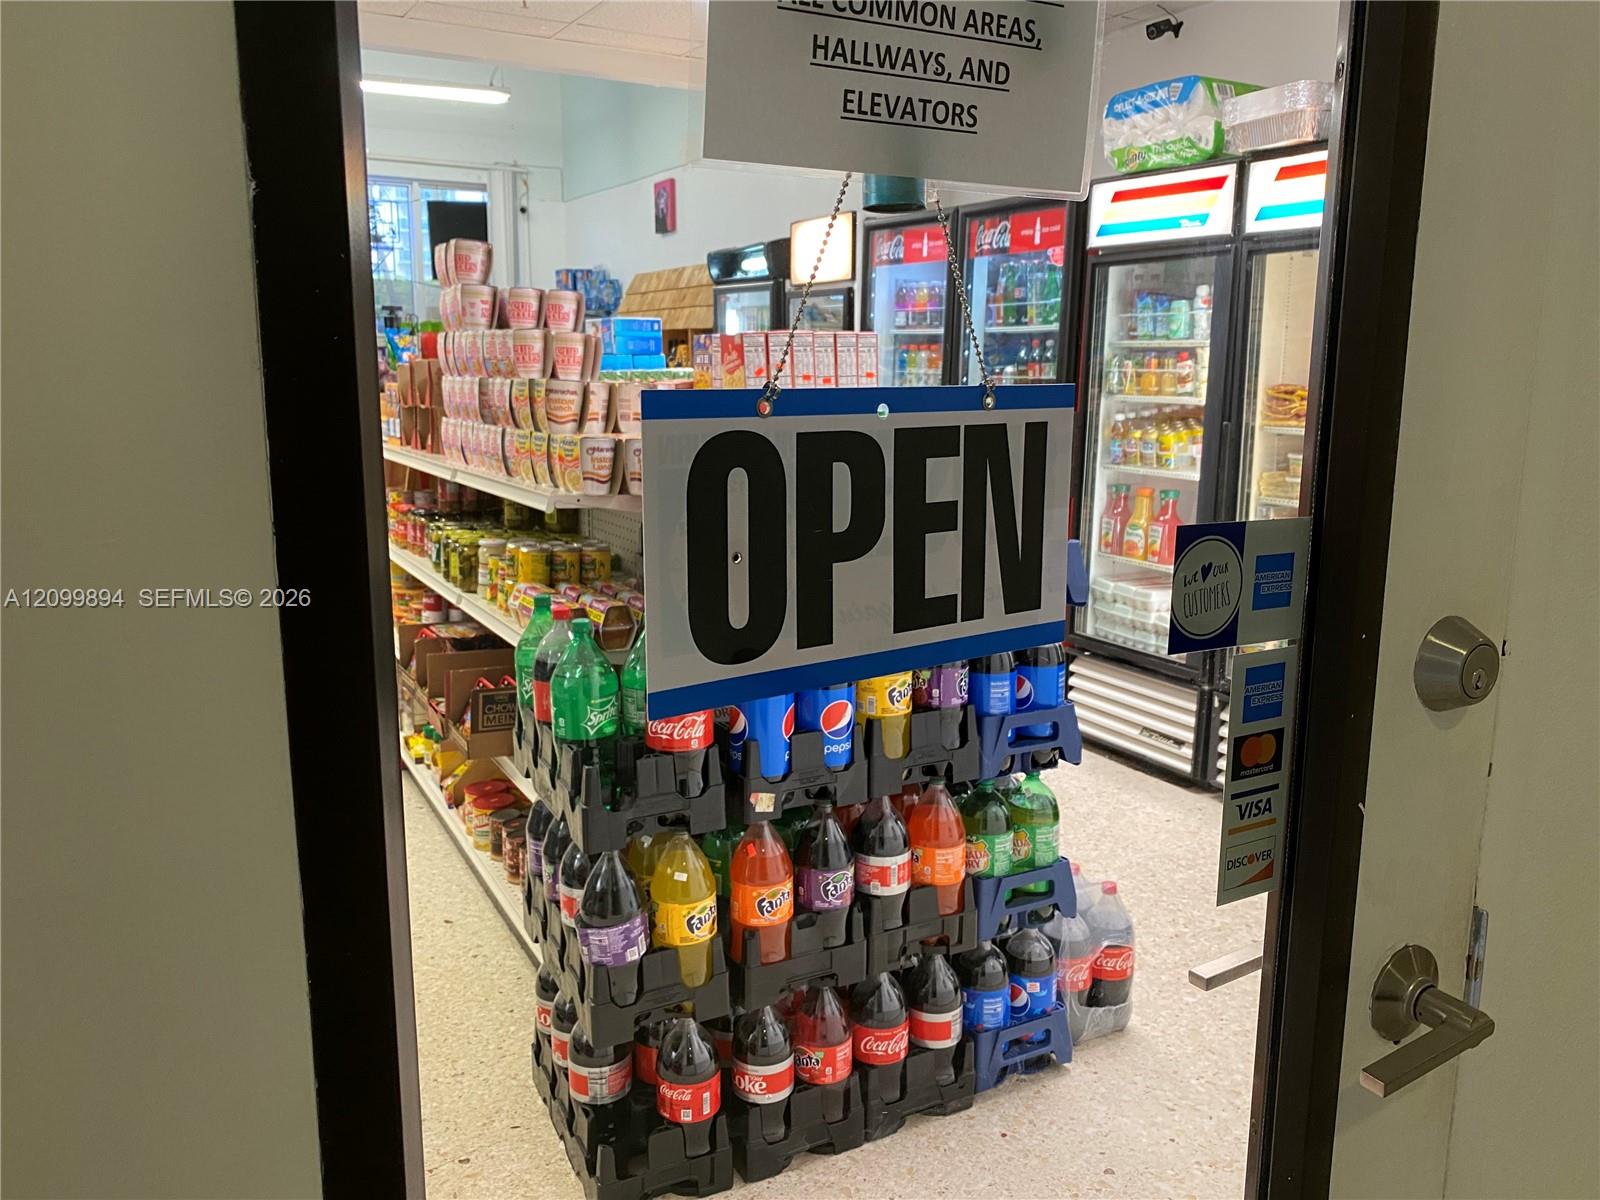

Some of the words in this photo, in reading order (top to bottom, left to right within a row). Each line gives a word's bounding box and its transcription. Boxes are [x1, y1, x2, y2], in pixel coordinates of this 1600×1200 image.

[963, 9, 1043, 47] AREAS,
[811, 34, 952, 83] HALLWAYS,
[959, 55, 1011, 86] AND
[841, 88, 978, 128] ELEVATORS
[686, 421, 1048, 665] OPEN
[1255, 571, 1291, 583] AMERICAN
[1260, 582, 1293, 594] EXPRESS
[1183, 581, 1231, 619] CUSTOMERS
[1244, 680, 1282, 695] AMERICAN
[1250, 692, 1284, 706] EXPRESS
[1240, 763, 1274, 777] mastercard
[1236, 797, 1273, 821] VISA
[1226, 849, 1273, 870] DISCOVER
[756, 888, 790, 918] Fanta
